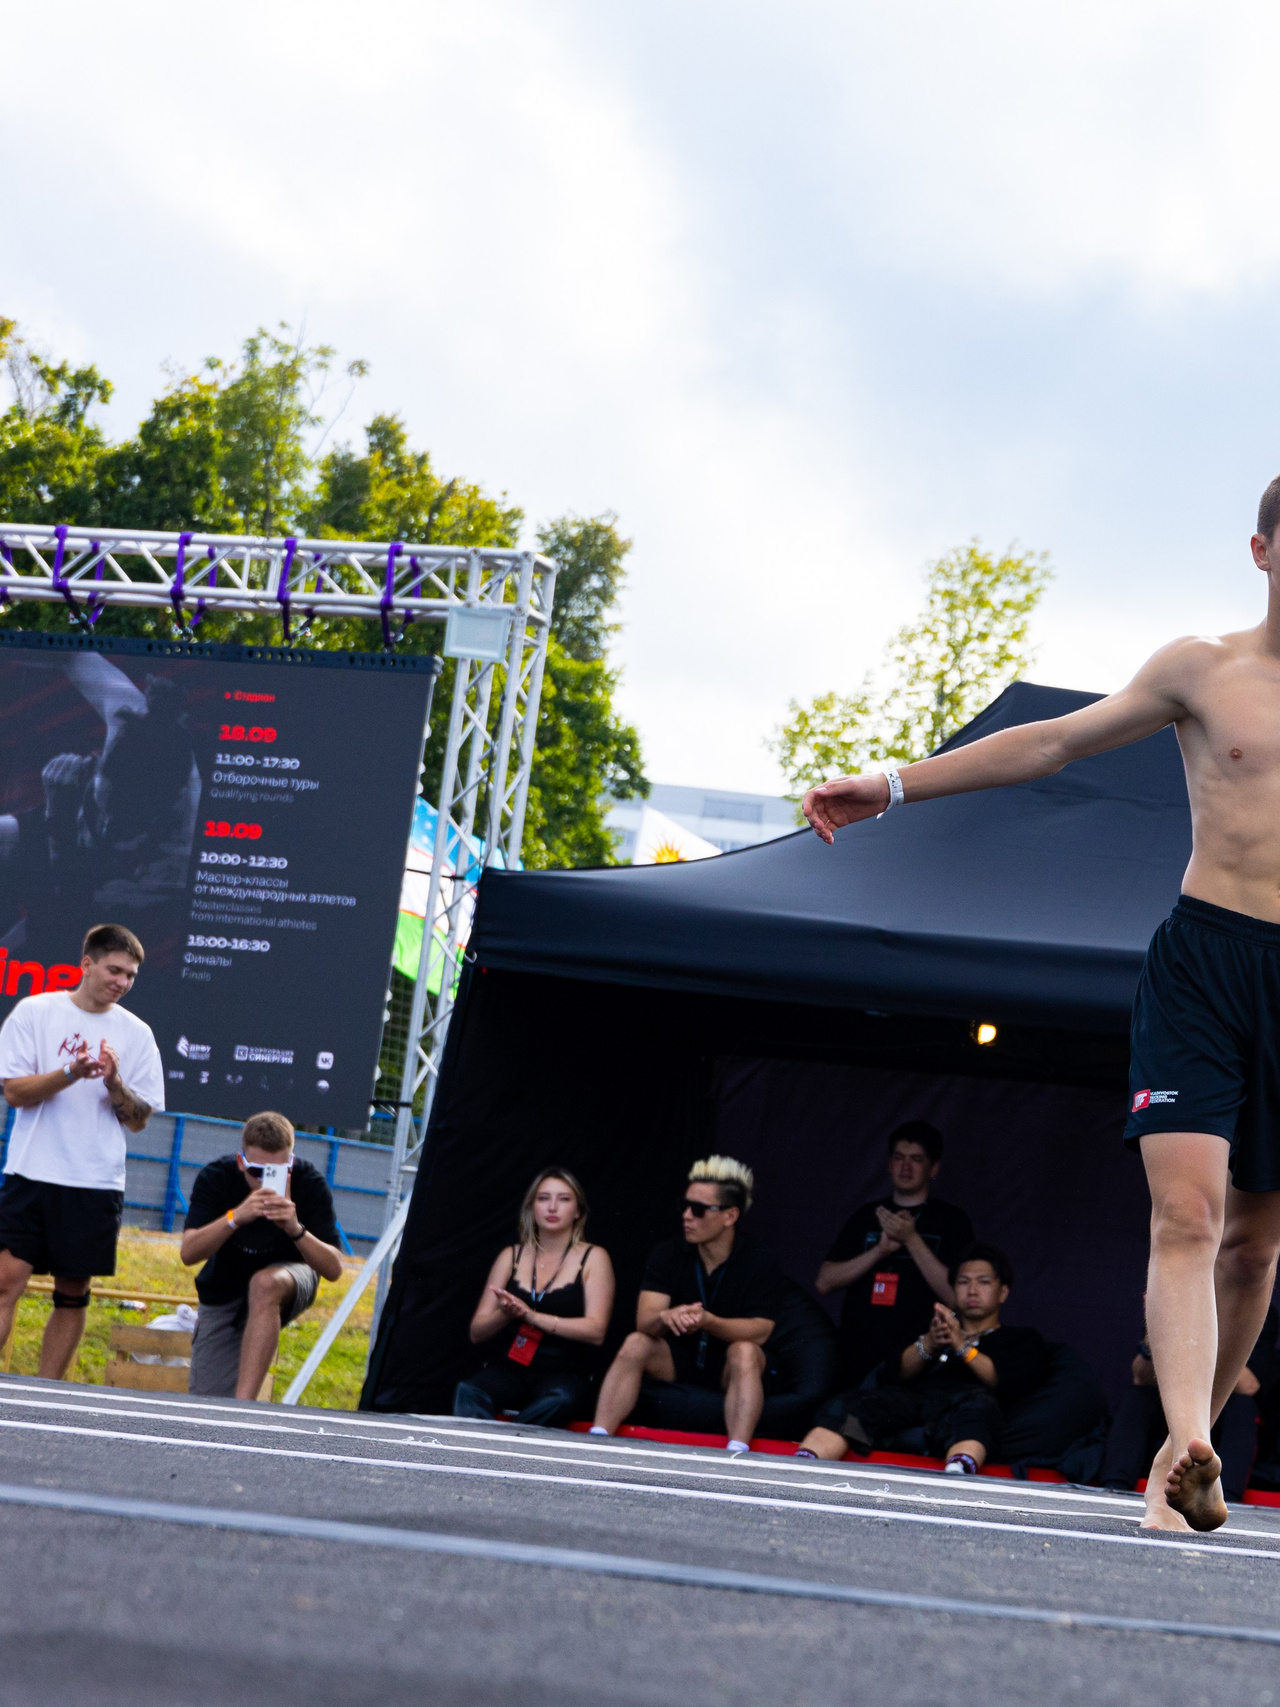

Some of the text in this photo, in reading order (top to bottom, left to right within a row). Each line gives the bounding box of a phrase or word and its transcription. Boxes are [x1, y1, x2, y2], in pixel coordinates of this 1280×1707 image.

[219, 724, 277, 743] 18.09
[212, 771, 319, 791] Отборочные туры
[211, 788, 258, 803] Qualifying
[204, 820, 262, 840] 19.09
[196, 870, 289, 888] Мастер-классы
[194, 885, 357, 907] от международных атлетов
[192, 900, 262, 914] Masterclasses
[191, 911, 317, 931] from international athletes
[184, 952, 232, 967] Финалы
[181, 967, 211, 982] Finals
